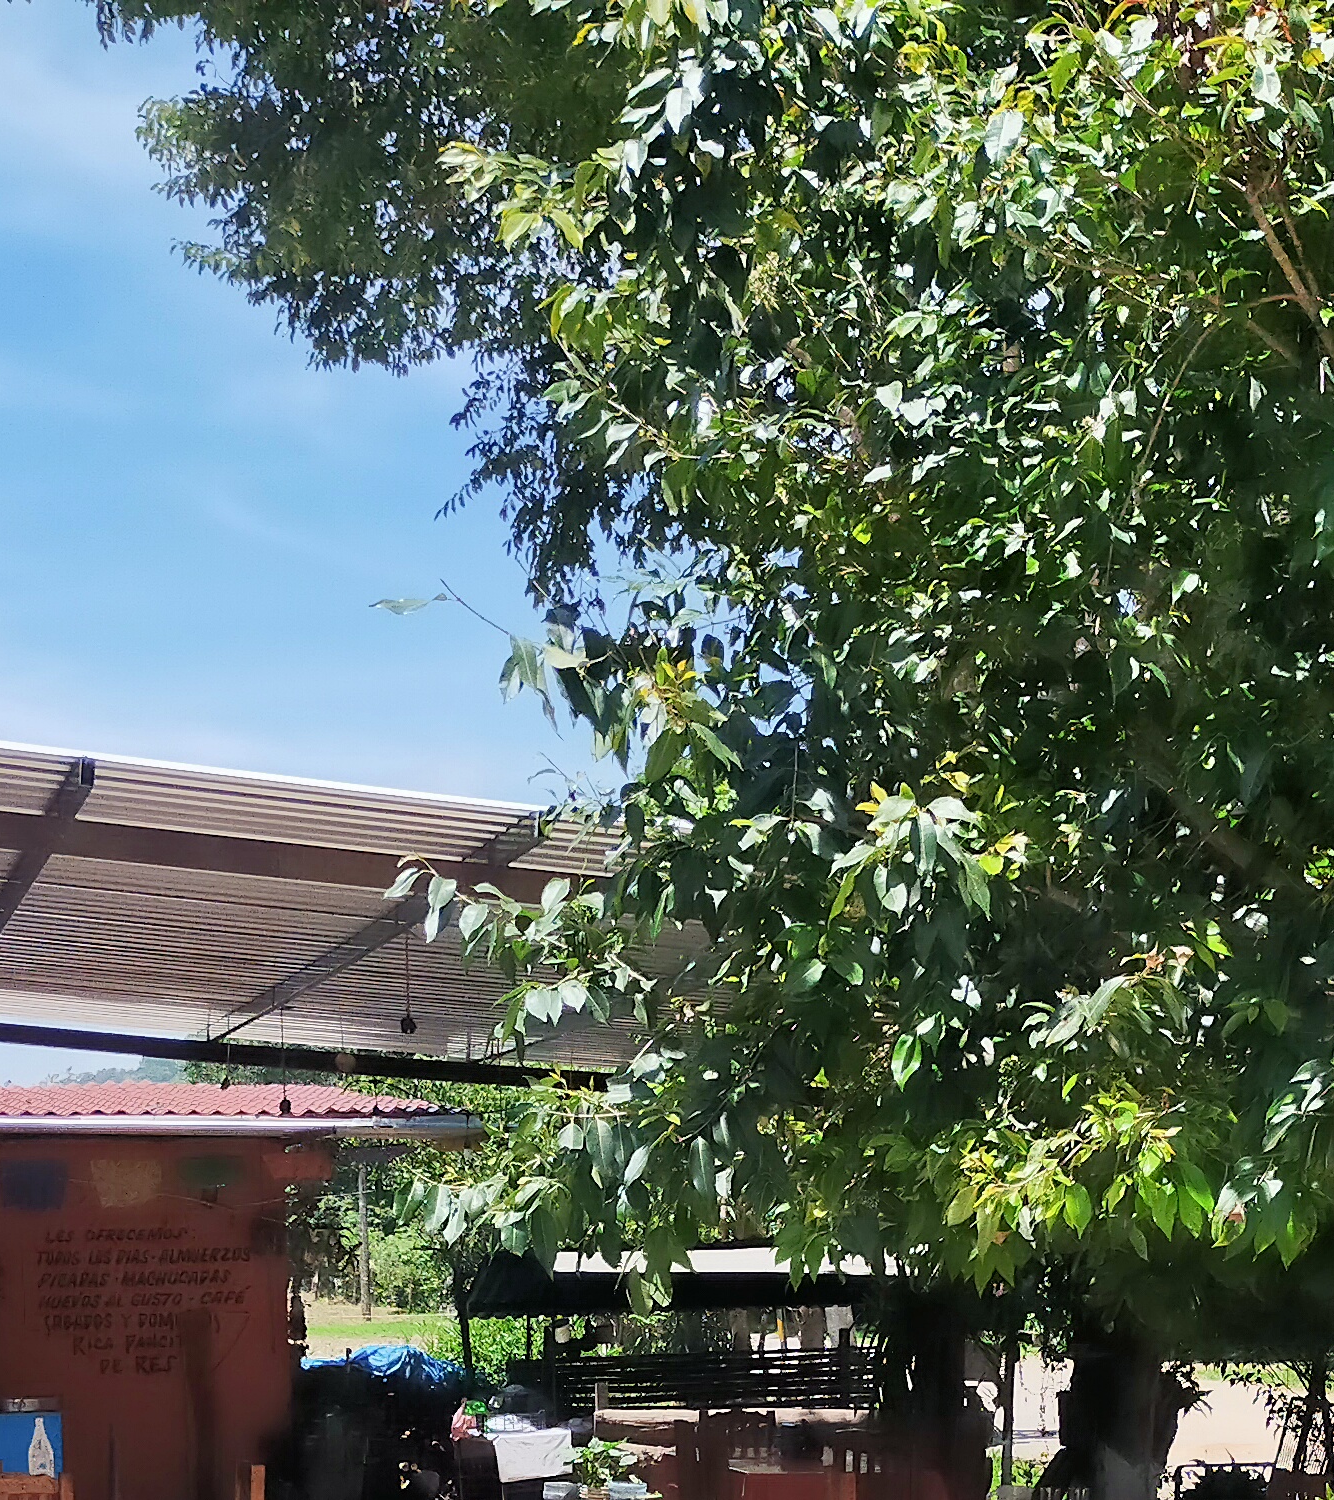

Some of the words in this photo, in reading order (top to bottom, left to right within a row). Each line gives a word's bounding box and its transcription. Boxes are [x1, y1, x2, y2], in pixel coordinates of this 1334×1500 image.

[131, 1292, 183, 1307] GUSTO
[120, 1313, 131, 1329] Y
[100, 1358, 123, 1375] DE
[135, 1355, 178, 1375] RES
